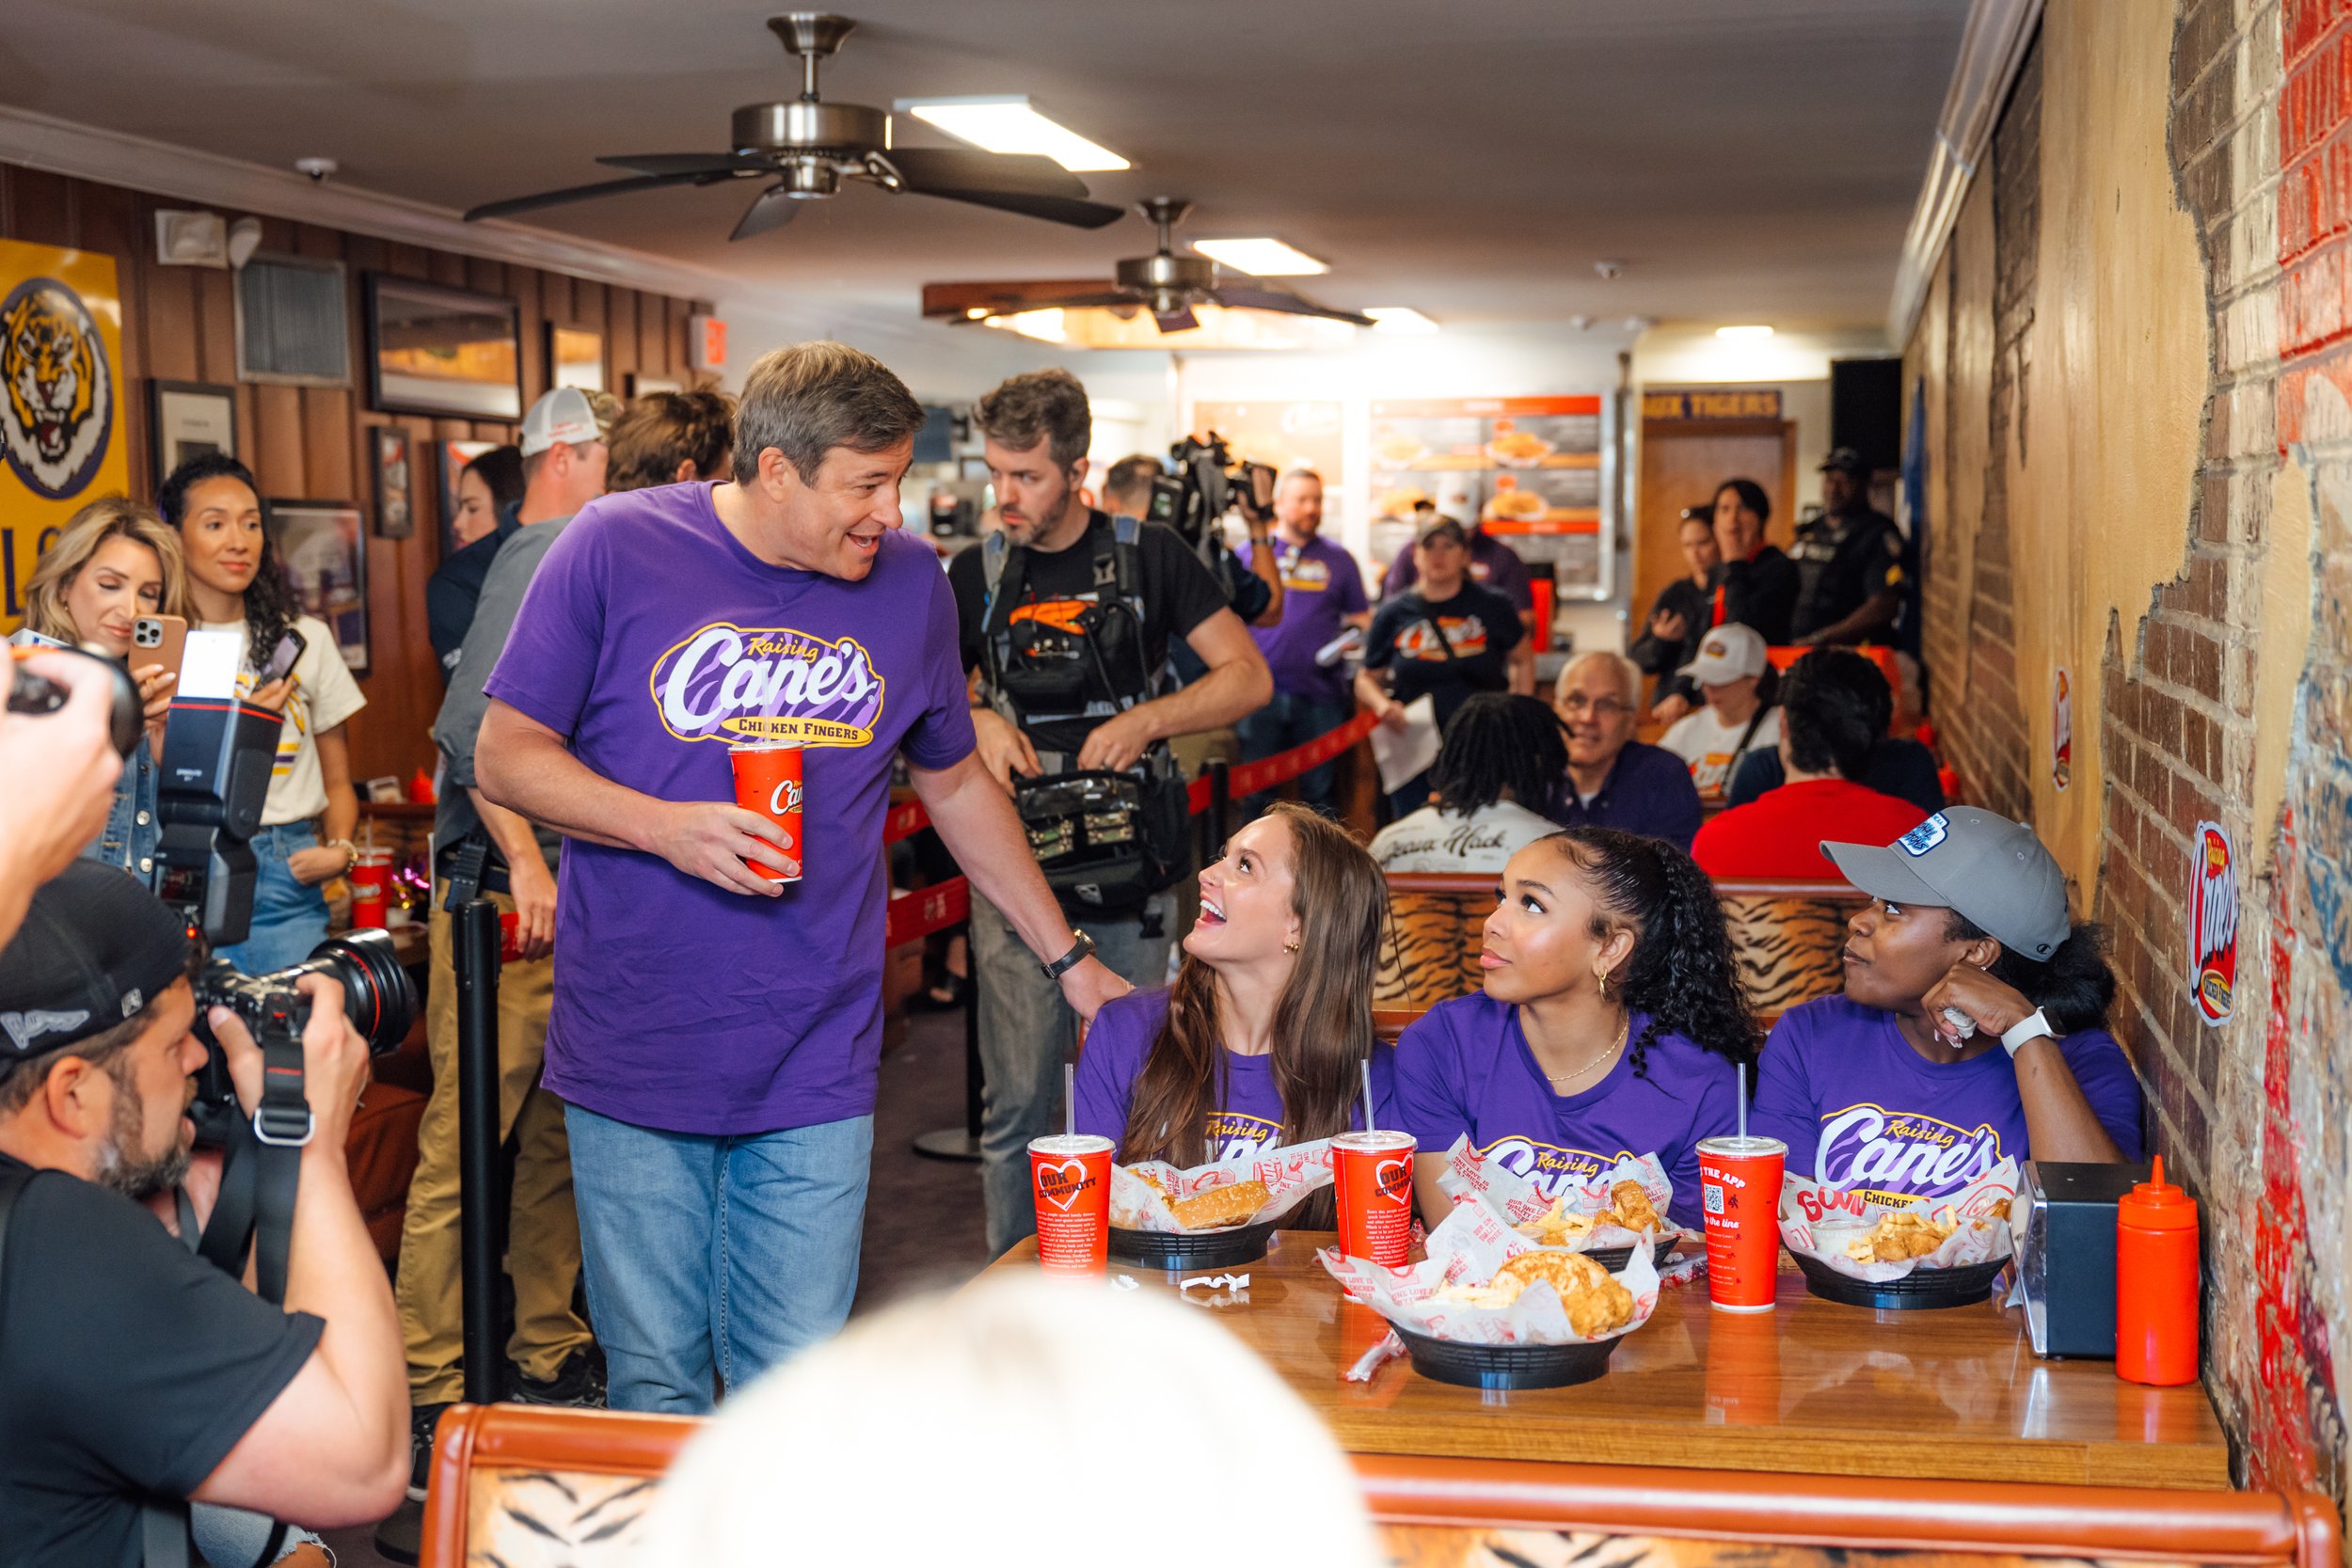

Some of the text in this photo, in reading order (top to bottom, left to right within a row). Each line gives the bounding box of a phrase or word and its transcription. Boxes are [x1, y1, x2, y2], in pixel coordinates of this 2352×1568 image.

[748, 637, 818, 663] Raising
[663, 628, 879, 730] Cane's
[739, 719, 859, 740] CHIKEN FINGERS
[1443, 825, 1508, 858] Hack
[1206, 1120, 1268, 1142] Raising
[1884, 1119, 1955, 1148] Raising
[1816, 1108, 1994, 1191] Cane's
[1466, 1166, 1482, 1181] LOVE
[1536, 1151, 1599, 1178] Raising
[1041, 1172, 1068, 1187] OUR
[1380, 1166, 1407, 1185] OUR
[1703, 1166, 1720, 1178] THE
[1722, 1173, 1746, 1189] APP
[1038, 1177, 1096, 1198] COMMUNITY
[1522, 1203, 1535, 1214] ONE
[1864, 1191, 1915, 1209] CHICKE
[1709, 1216, 1720, 1228] the
[1722, 1218, 1740, 1229] line
